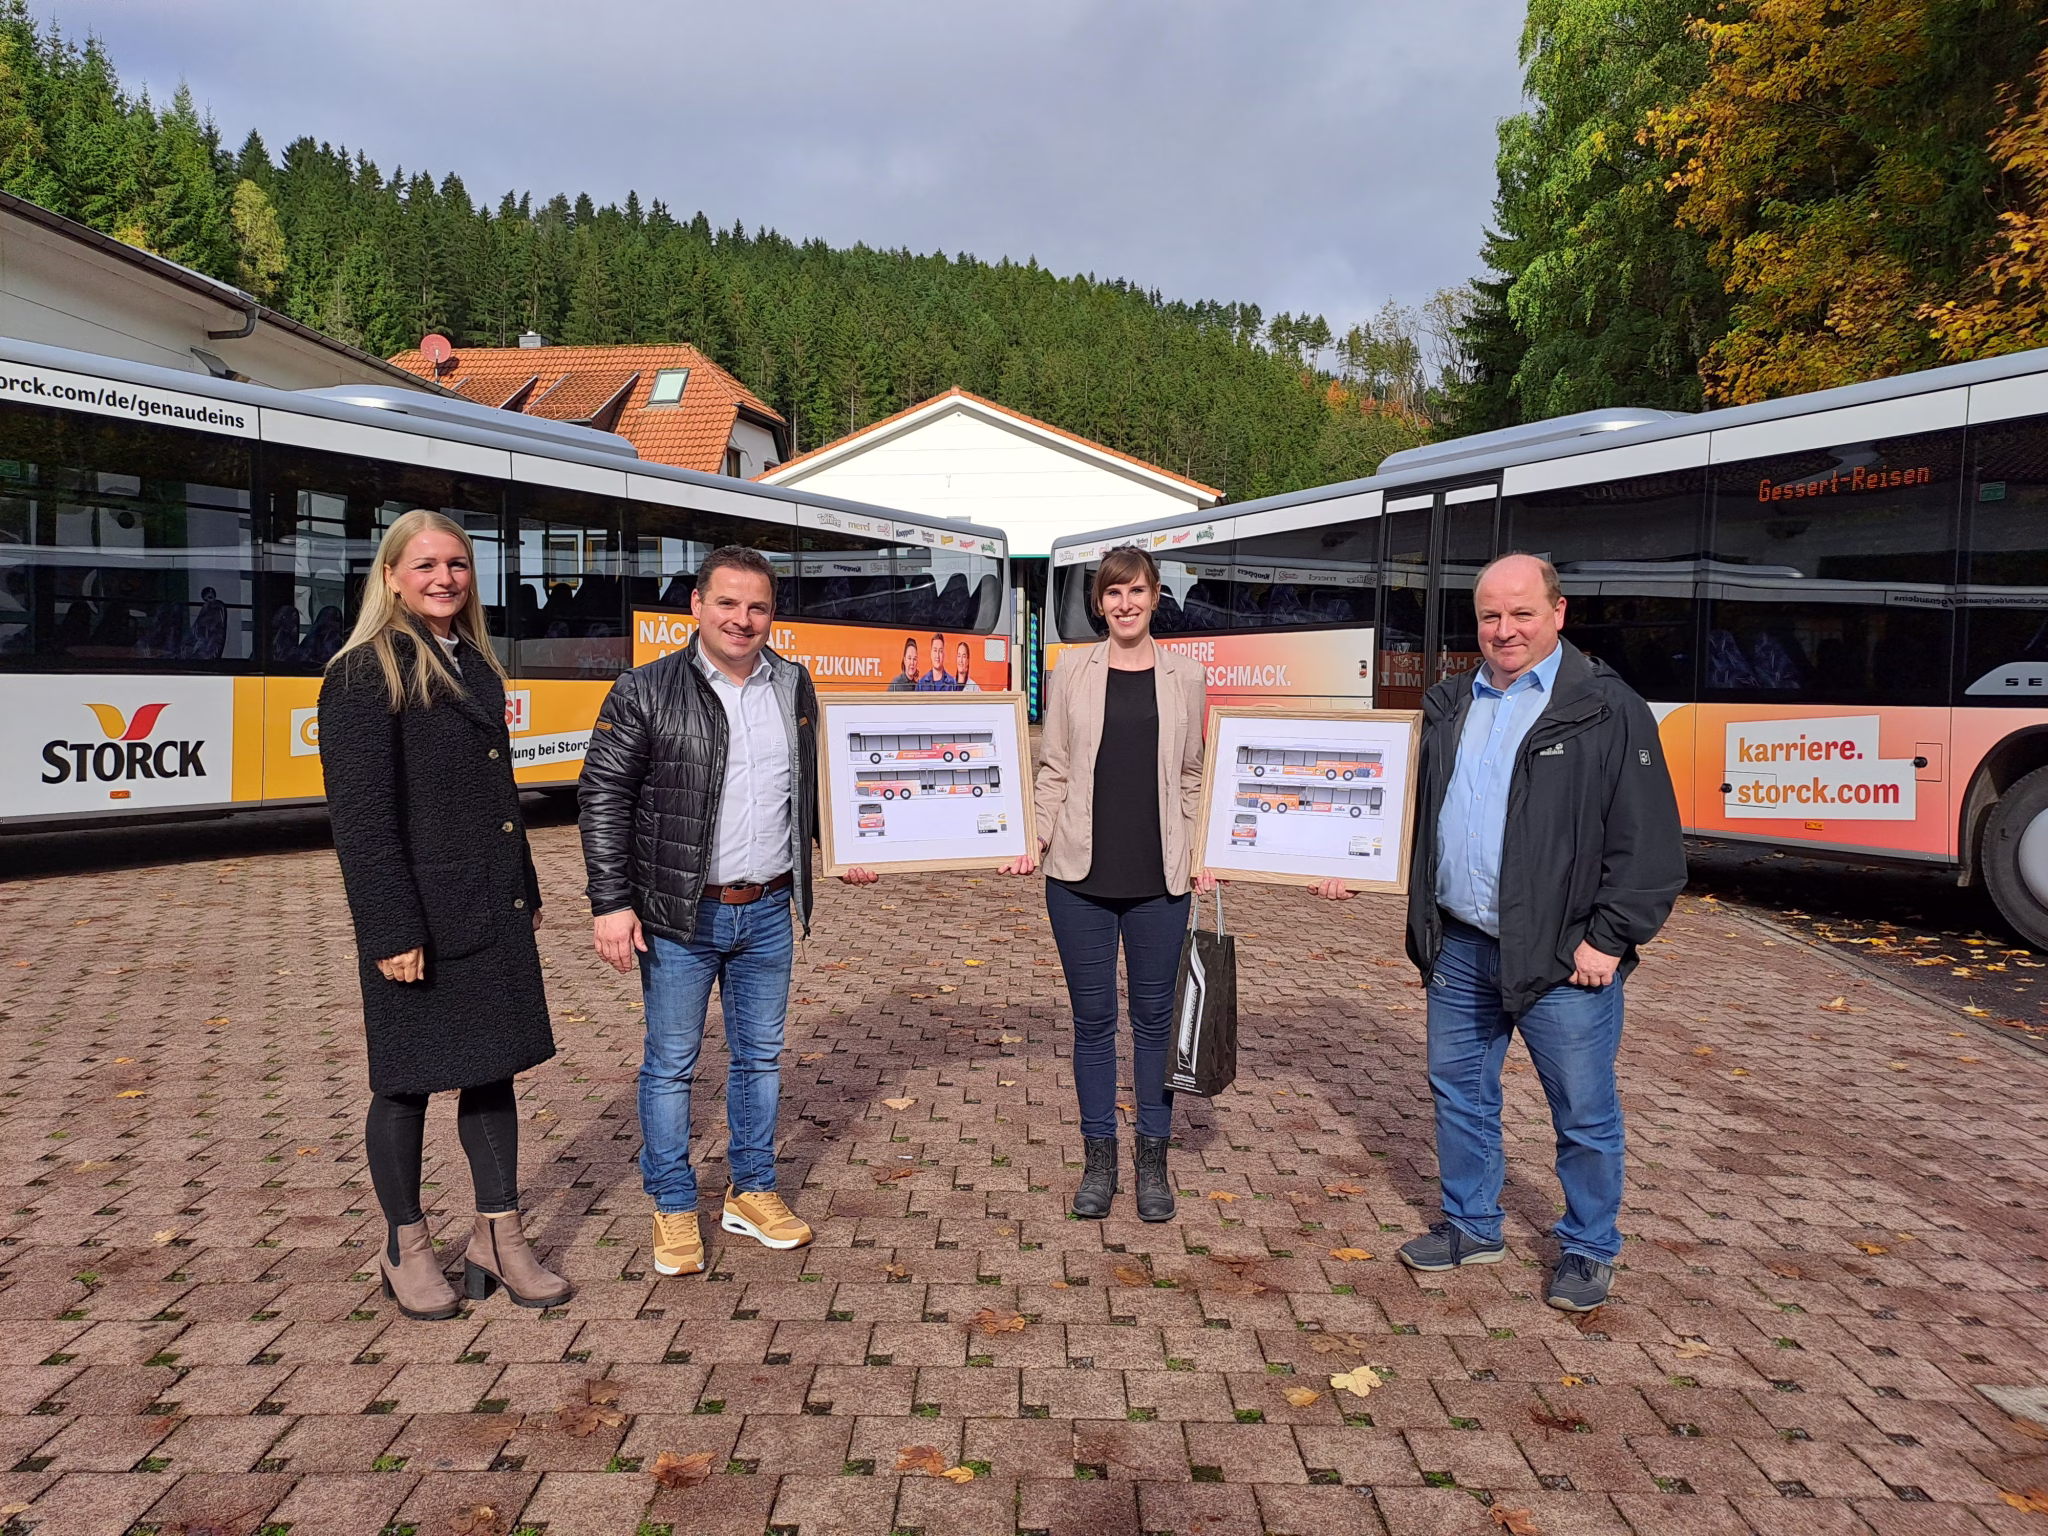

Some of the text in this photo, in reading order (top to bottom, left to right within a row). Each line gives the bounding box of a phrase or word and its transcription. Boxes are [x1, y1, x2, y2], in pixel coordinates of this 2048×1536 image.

[1758, 465, 1931, 503] Gessert-Reisen
[848, 521, 871, 532] merci
[895, 528, 915, 539] Knoppers
[639, 615, 796, 650] NÄCH ALT:
[815, 655, 883, 677] ZUKUNFT.
[1204, 664, 1293, 687] SCHMACK.
[2004, 677, 2044, 687] SE
[300, 716, 319, 746] G
[511, 738, 592, 761] ung bei Storc
[1738, 734, 1863, 763] karriere.
[41, 739, 208, 785] STORCK
[1737, 777, 1900, 805] storck.com
